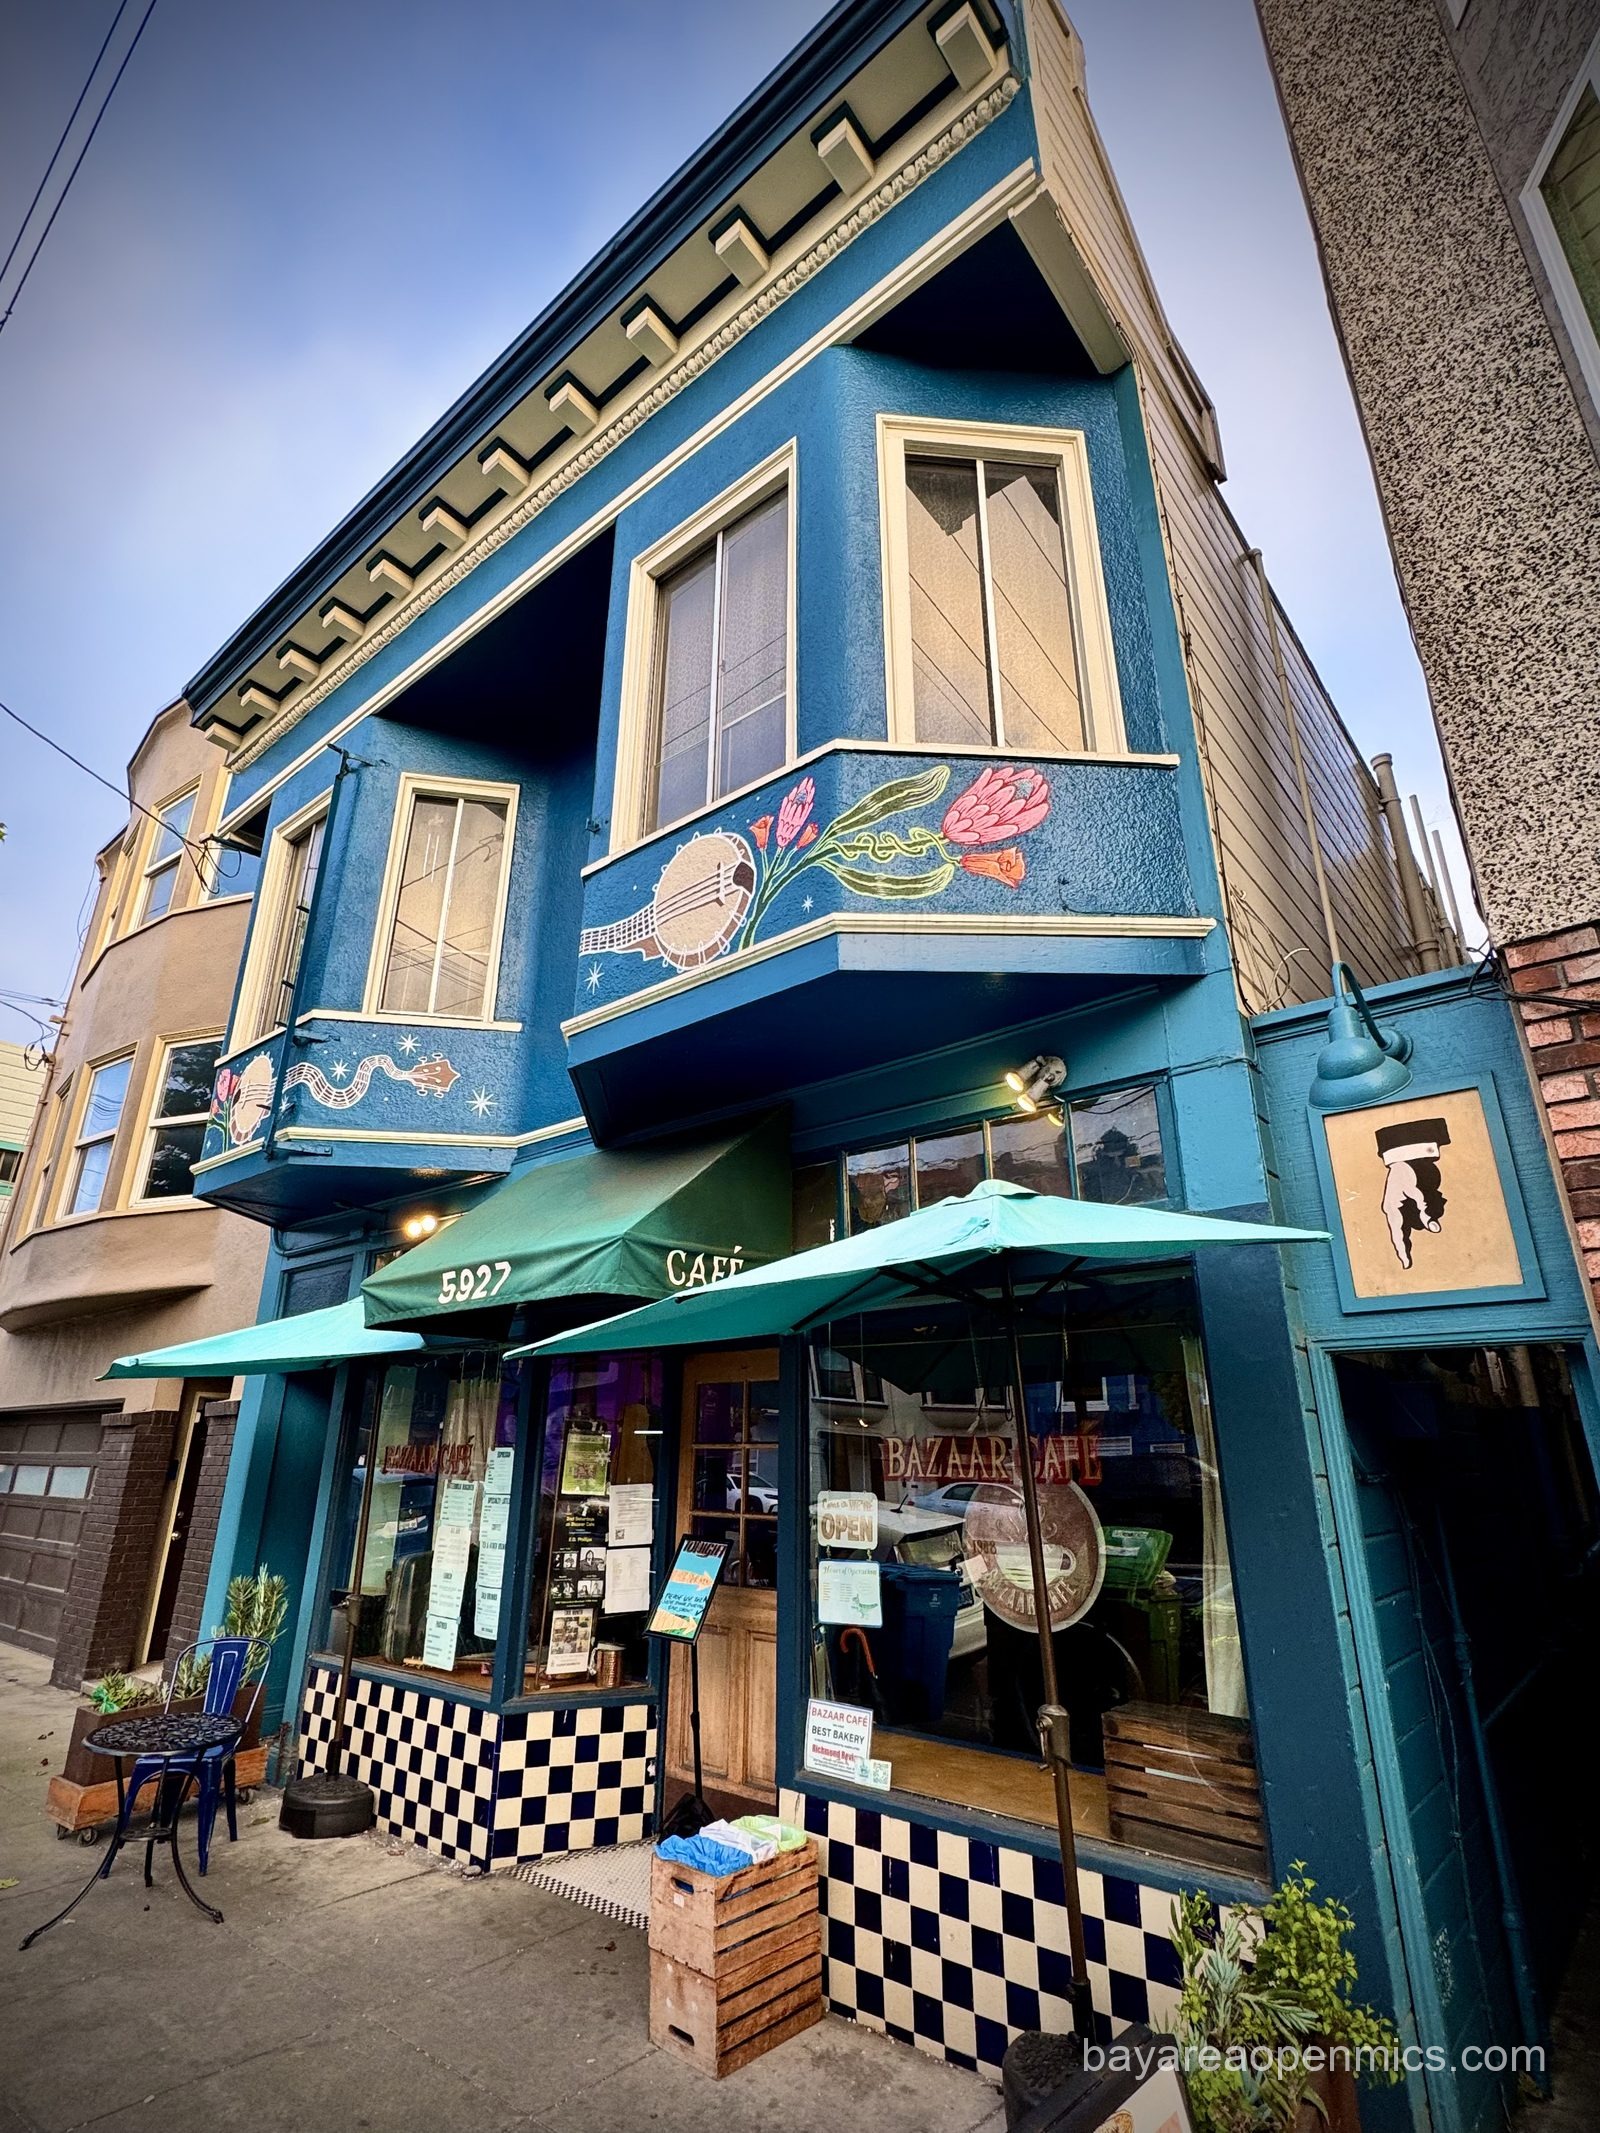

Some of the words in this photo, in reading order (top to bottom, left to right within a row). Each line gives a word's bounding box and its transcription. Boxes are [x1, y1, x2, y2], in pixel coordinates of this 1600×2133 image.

[438, 1261, 512, 1304] 5927
[881, 1435, 1011, 1482] BAZAAR
[821, 1513, 873, 1542] OPEN
[811, 1707, 845, 1722] BAZAAR
[846, 1713, 868, 1728] CAFÉ
[811, 1725, 831, 1737] BEST
[833, 1730, 865, 1745] BAKERY
[812, 1744, 841, 1759] Richmond
